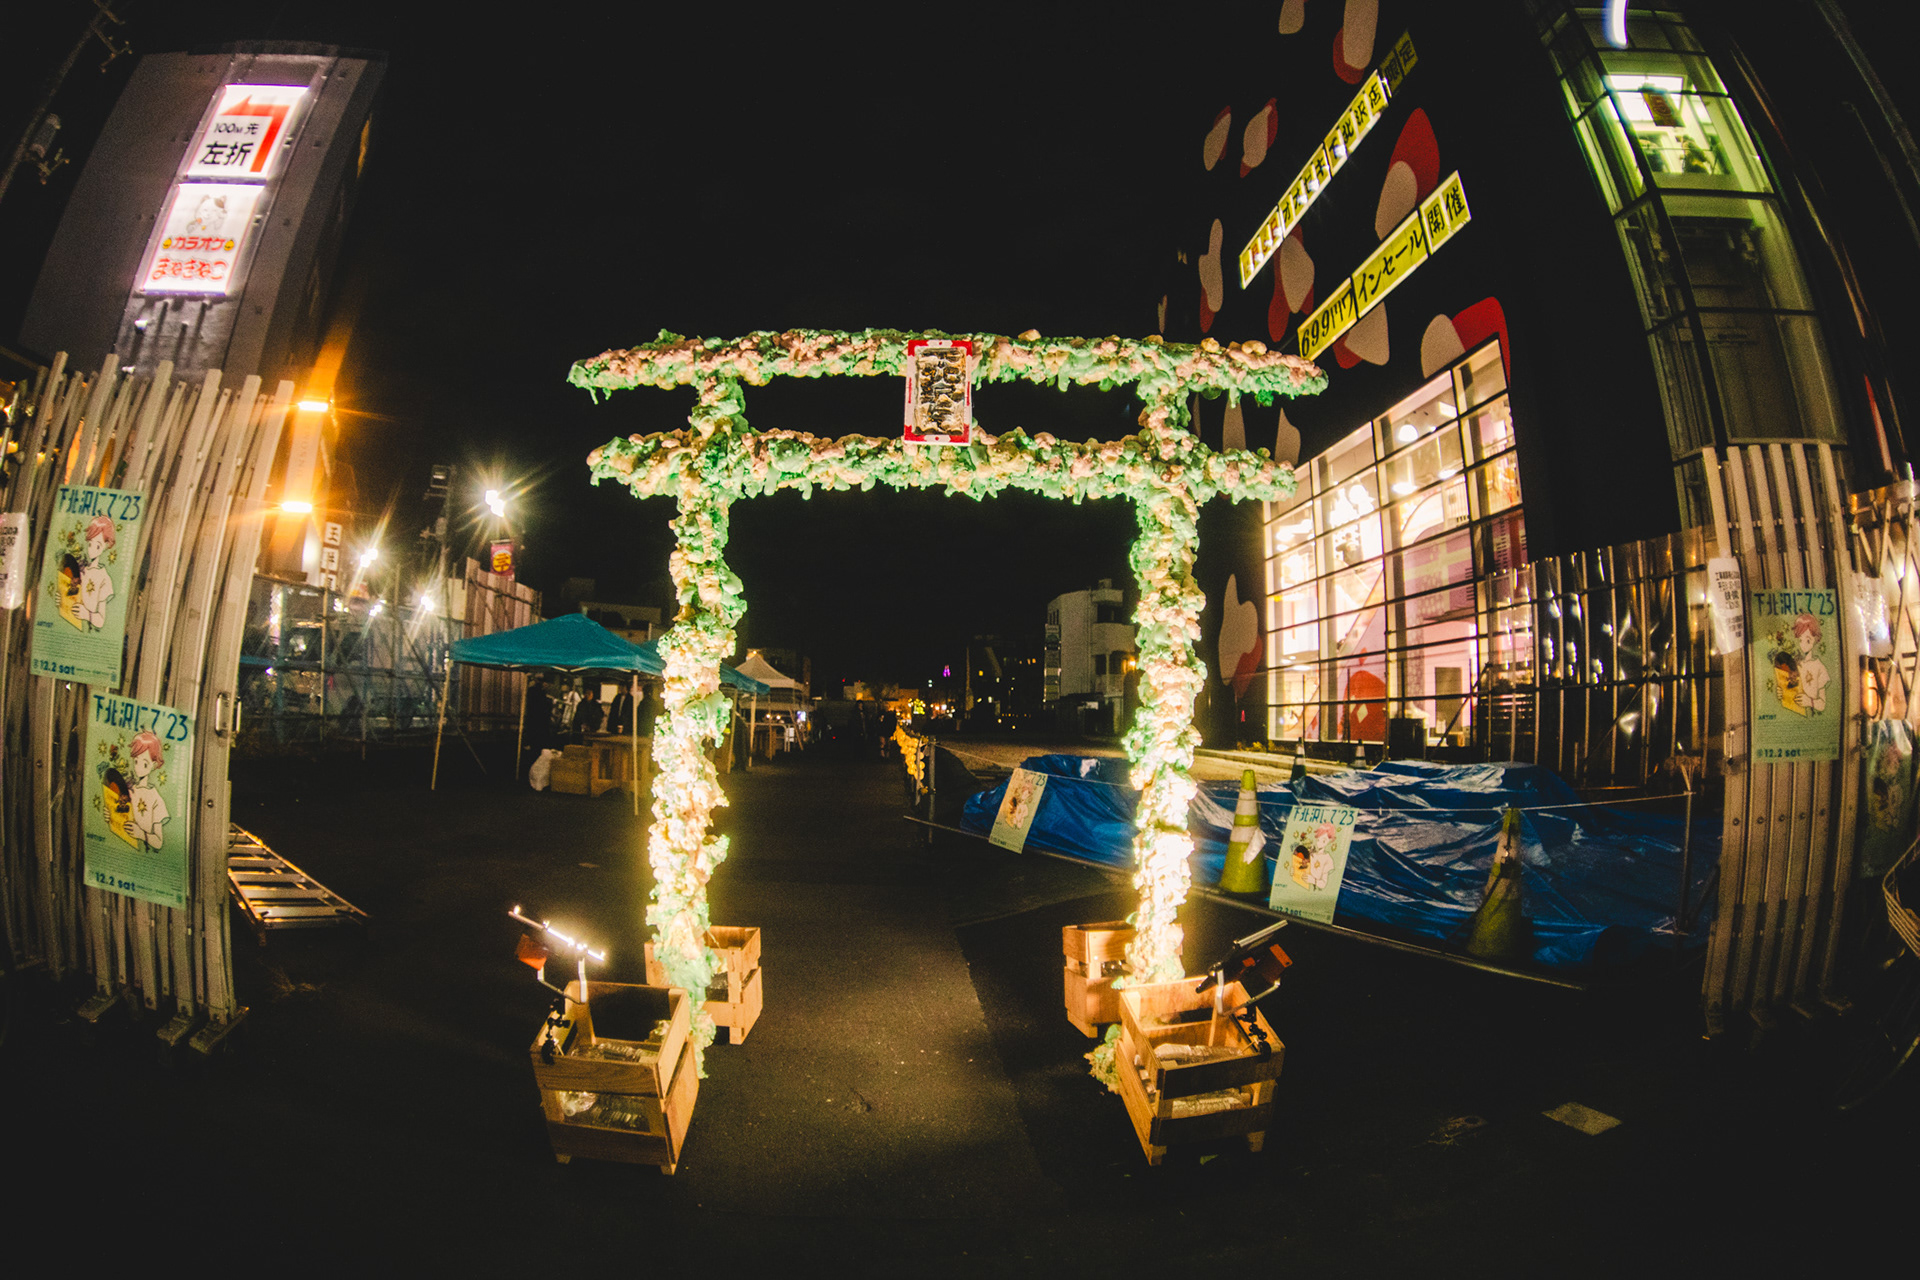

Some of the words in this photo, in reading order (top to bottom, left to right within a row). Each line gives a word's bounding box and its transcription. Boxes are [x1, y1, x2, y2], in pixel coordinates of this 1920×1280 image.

[199, 140, 254, 166] 左折
[171, 236, 227, 251] カラオケ
[151, 256, 228, 281] まねきねこ
[40, 660, 57, 673] 12.2
[58, 664, 76, 675] sat
[95, 872, 115, 886] 12.2
[117, 879, 136, 892] sat
